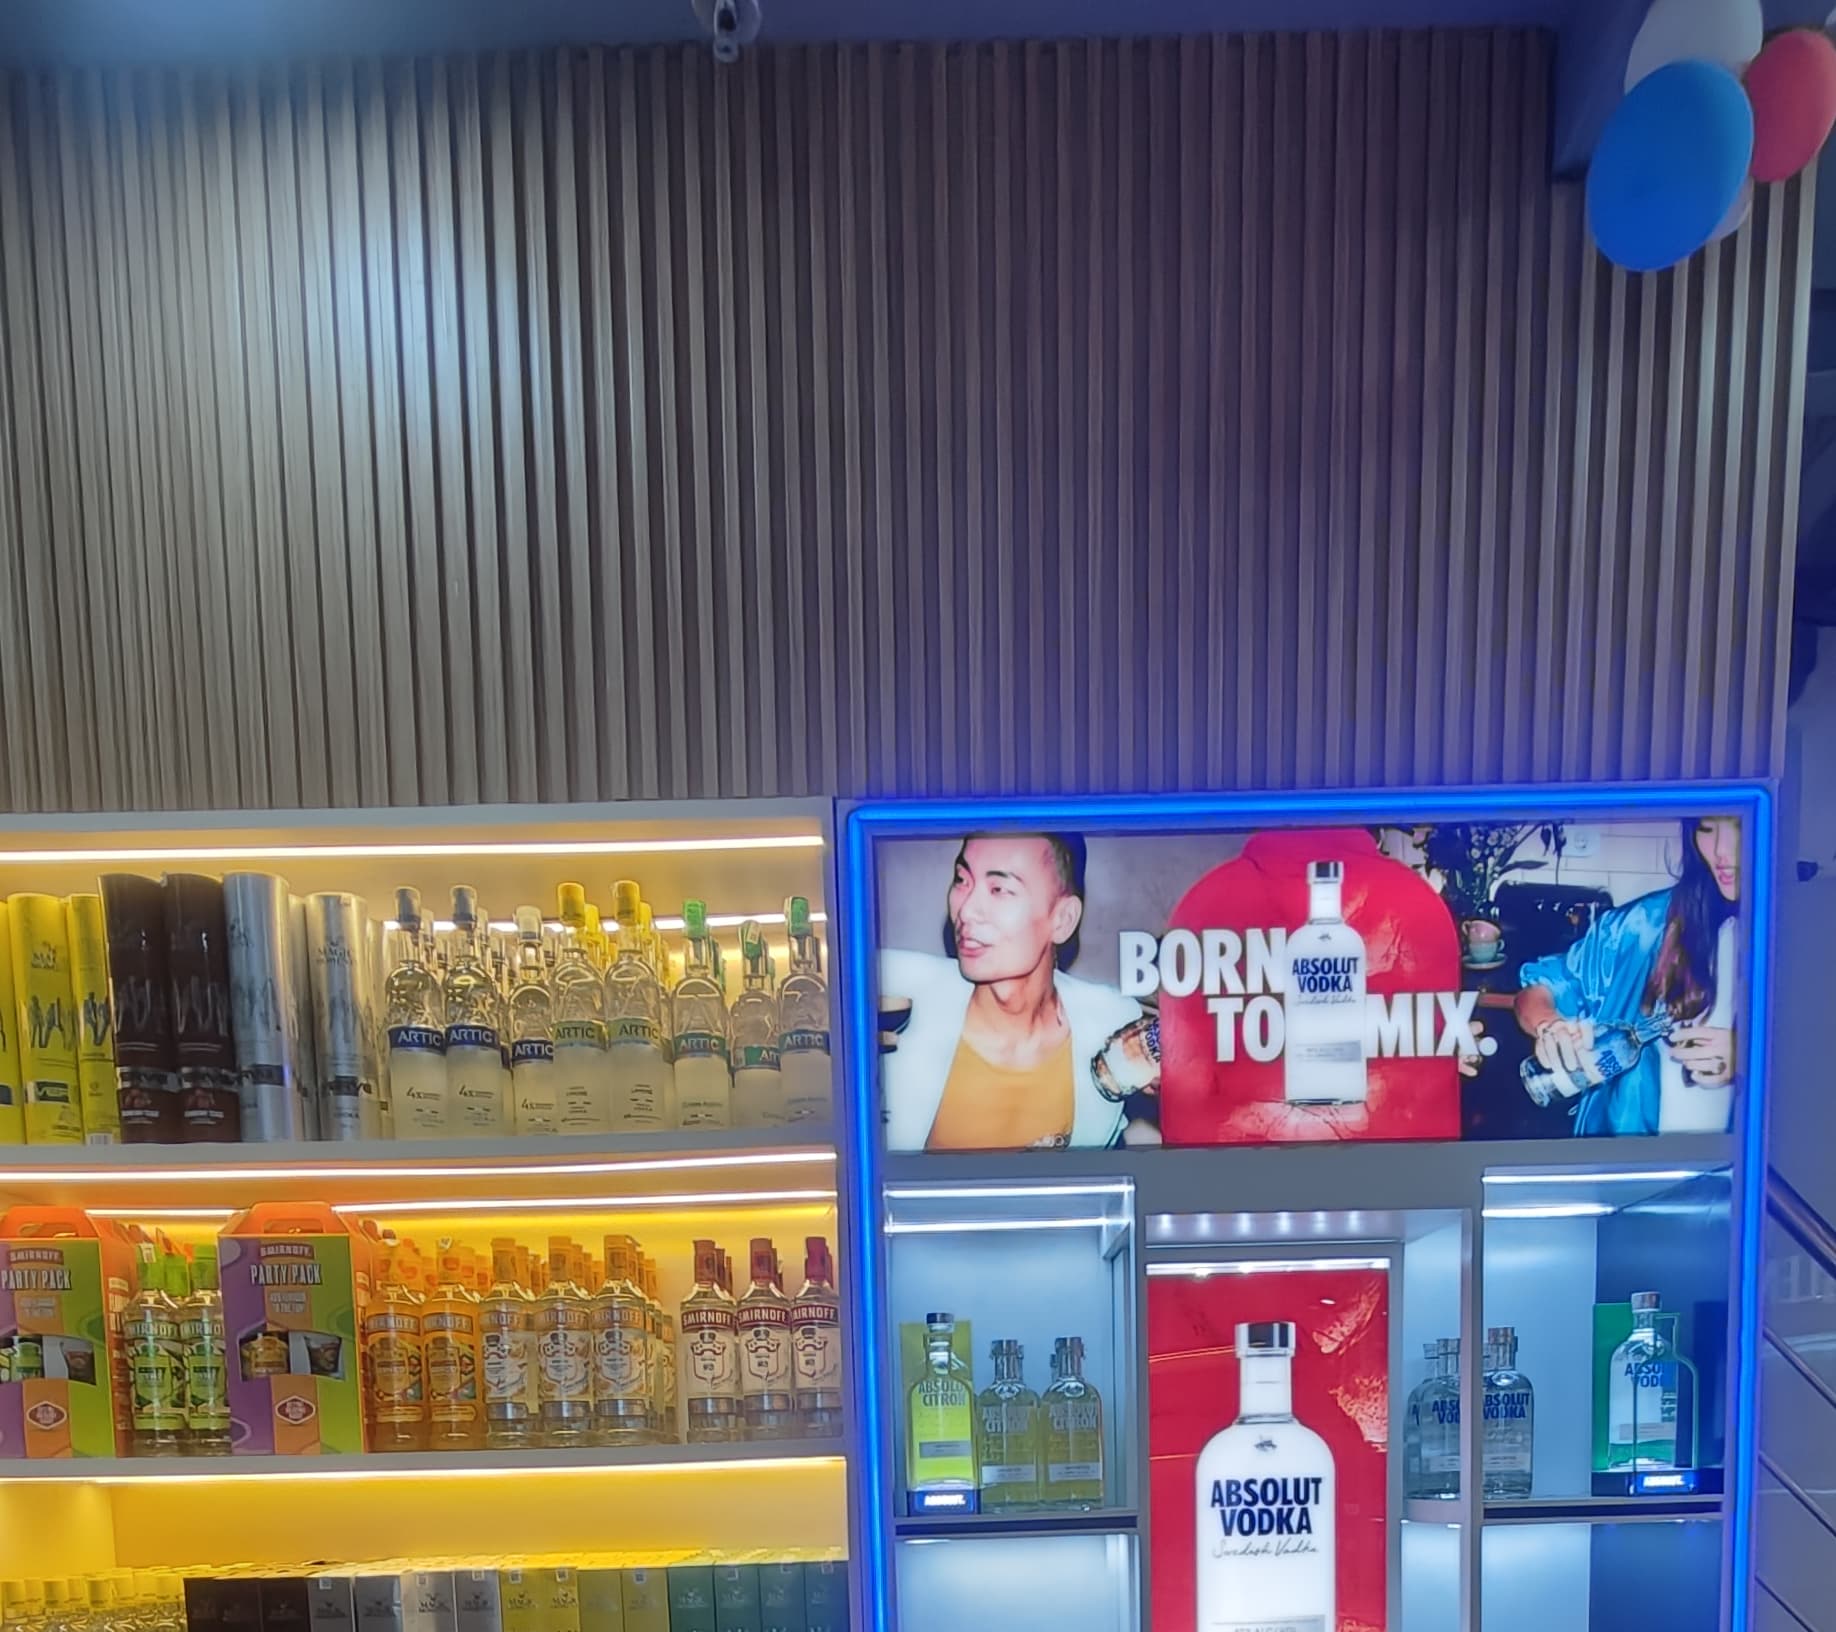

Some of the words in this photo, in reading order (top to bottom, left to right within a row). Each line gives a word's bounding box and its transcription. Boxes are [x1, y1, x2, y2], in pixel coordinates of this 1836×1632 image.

[1119, 928, 1286, 996] BORN
[1292, 956, 1359, 976] ABSOLUT
[1298, 975, 1352, 993] VODKA
[555, 1026, 595, 1039] ARTIC
[619, 1024, 659, 1039] ARTIC
[1208, 995, 1286, 1062] TO
[1365, 991, 1498, 1058] MIX.
[399, 1029, 441, 1046] ARTIC
[450, 1028, 493, 1043] ARTIC
[785, 1034, 823, 1047] ARTIC
[515, 1043, 553, 1056] ARTIC
[680, 1038, 719, 1050] ARTIC
[1, 1268, 38, 1290] PARTY
[41, 1268, 72, 1290] PACK
[250, 1264, 288, 1285] PARTY
[291, 1264, 322, 1285] PACK
[682, 1311, 732, 1326] SMIRNOFF
[738, 1309, 787, 1323] SMIRNOFF
[923, 1393, 966, 1408] CITRON
[1484, 1393, 1530, 1407] BSOLUT
[1210, 1477, 1323, 1508] ABSOLUT
[1220, 1507, 1312, 1537] VODKA
[1273, 1538, 1319, 1557] Vodka
